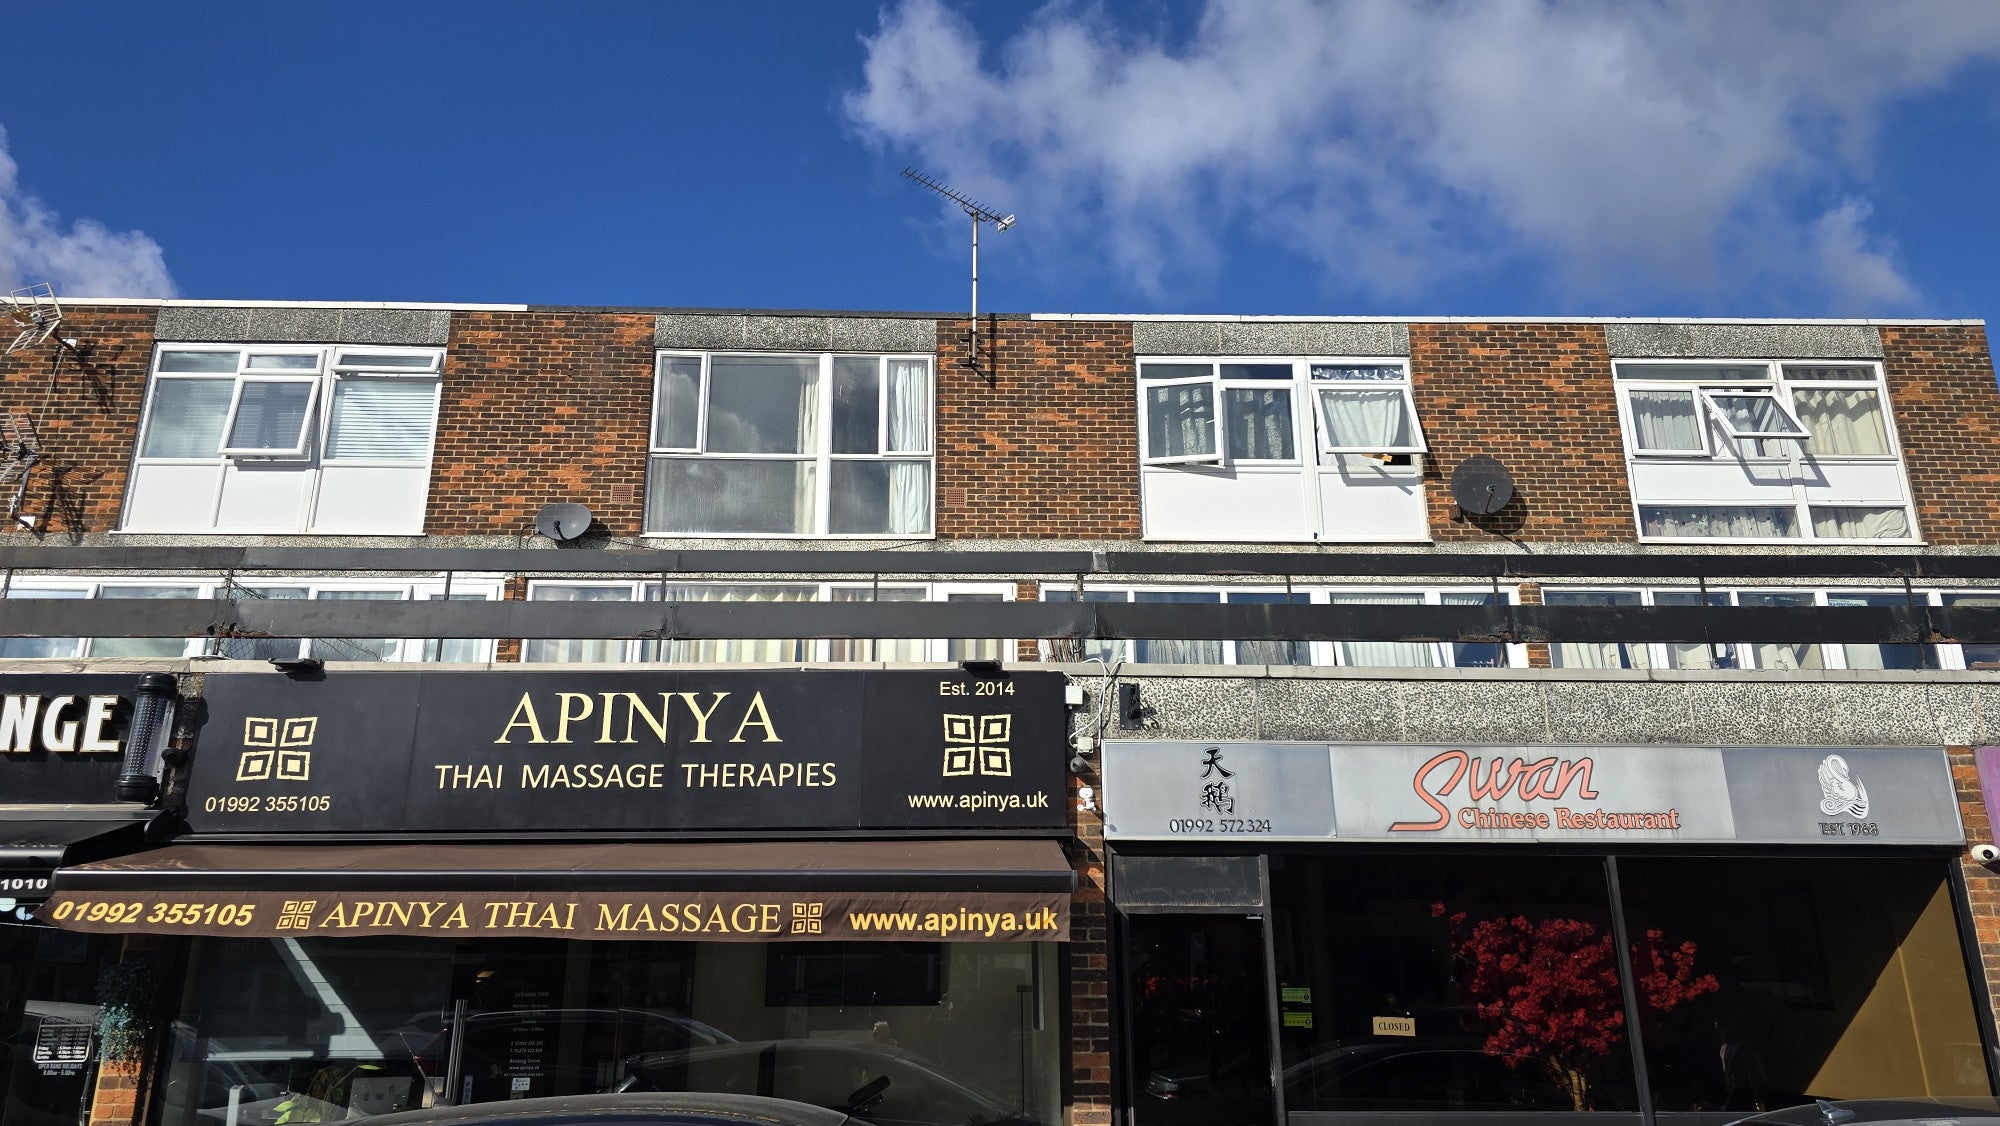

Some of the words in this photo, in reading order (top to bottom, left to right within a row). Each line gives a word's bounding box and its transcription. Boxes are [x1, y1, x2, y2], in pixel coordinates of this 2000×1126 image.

[939, 681, 970, 696] Est.
[975, 681, 1015, 696] 2014
[0, 694, 120, 753] NGE
[494, 691, 784, 744] APINYA
[434, 764, 503, 789] THAI
[521, 763, 665, 788] MASSAGE
[681, 762, 837, 787] THERAPIES
[907, 790, 1049, 812] www.apinya.uk
[1390, 749, 1600, 832] Swan
[204, 796, 261, 813] 01992
[264, 795, 331, 812] 355105
[1169, 818, 1215, 833] 01992
[1219, 818, 1272, 833] 572324
[1457, 807, 1551, 830] Chinese
[1553, 807, 1681, 830] Restaurant
[1847, 821, 1879, 836] 1968
[0, 878, 48, 891] 1010
[51, 900, 144, 924] 01992
[146, 902, 257, 928] 355105
[319, 901, 470, 929] APINYA
[485, 902, 579, 930] THAI
[595, 903, 782, 933] MASSAGE
[848, 906, 1059, 937] www.apinya.uk
[1378, 1021, 1411, 1032] CLOSED
